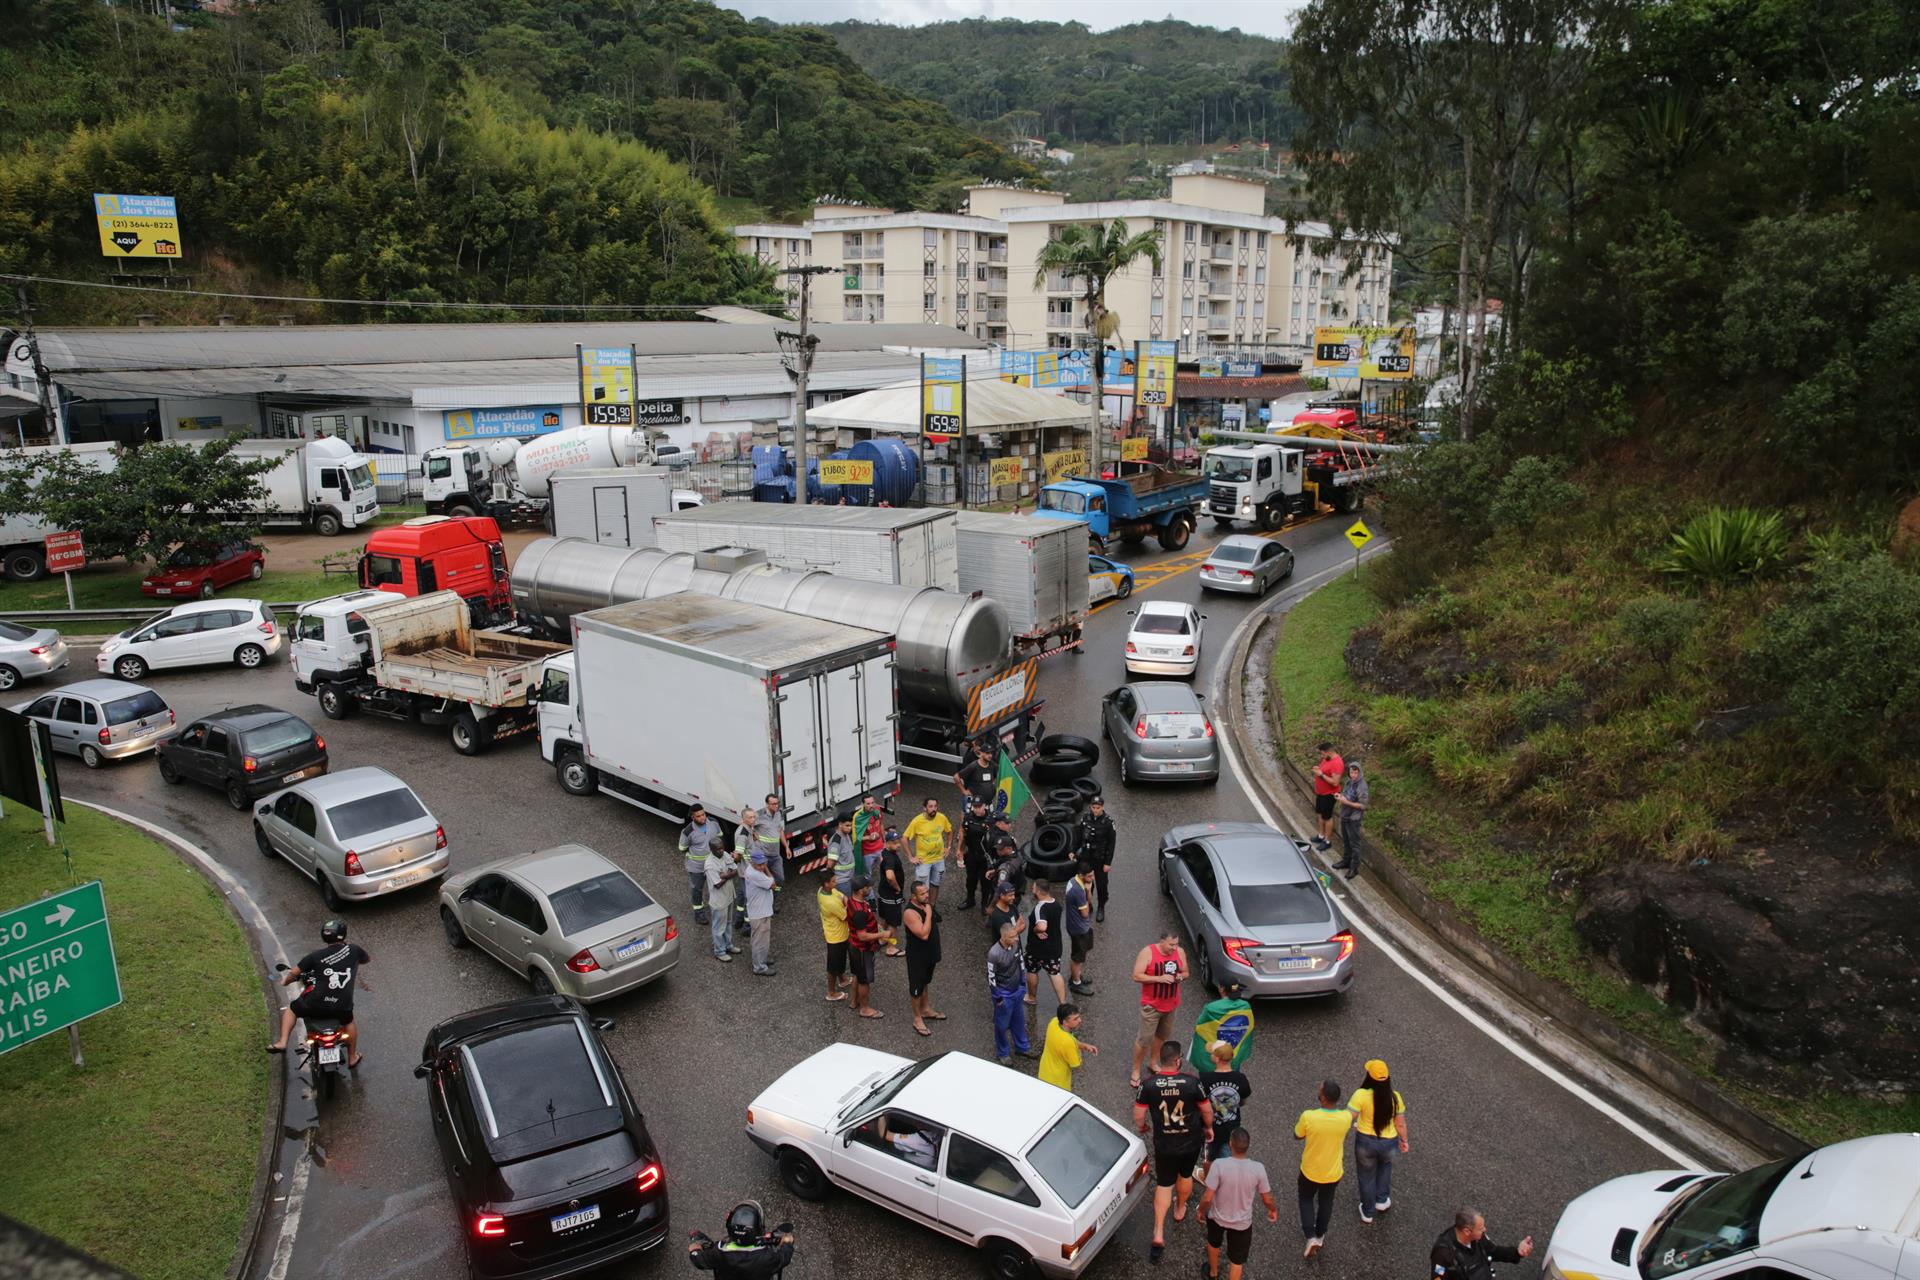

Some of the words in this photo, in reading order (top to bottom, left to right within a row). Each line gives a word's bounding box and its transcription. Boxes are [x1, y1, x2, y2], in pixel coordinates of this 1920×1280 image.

[122, 196, 173, 207] Atacadão
[122, 206, 143, 214] dos
[145, 207, 174, 215] Pisos
[113, 220, 128, 228] (21)
[130, 221, 173, 229] 3644-8222
[476, 409, 535, 422] Atacadão
[477, 424, 499, 435] dos
[503, 421, 536, 433] Pisos
[528, 446, 588, 467] concreto
[823, 465, 846, 476] TUBOS
[1160, 1087, 1180, 1096] LEITÃO
[1158, 1099, 1185, 1126] 14
